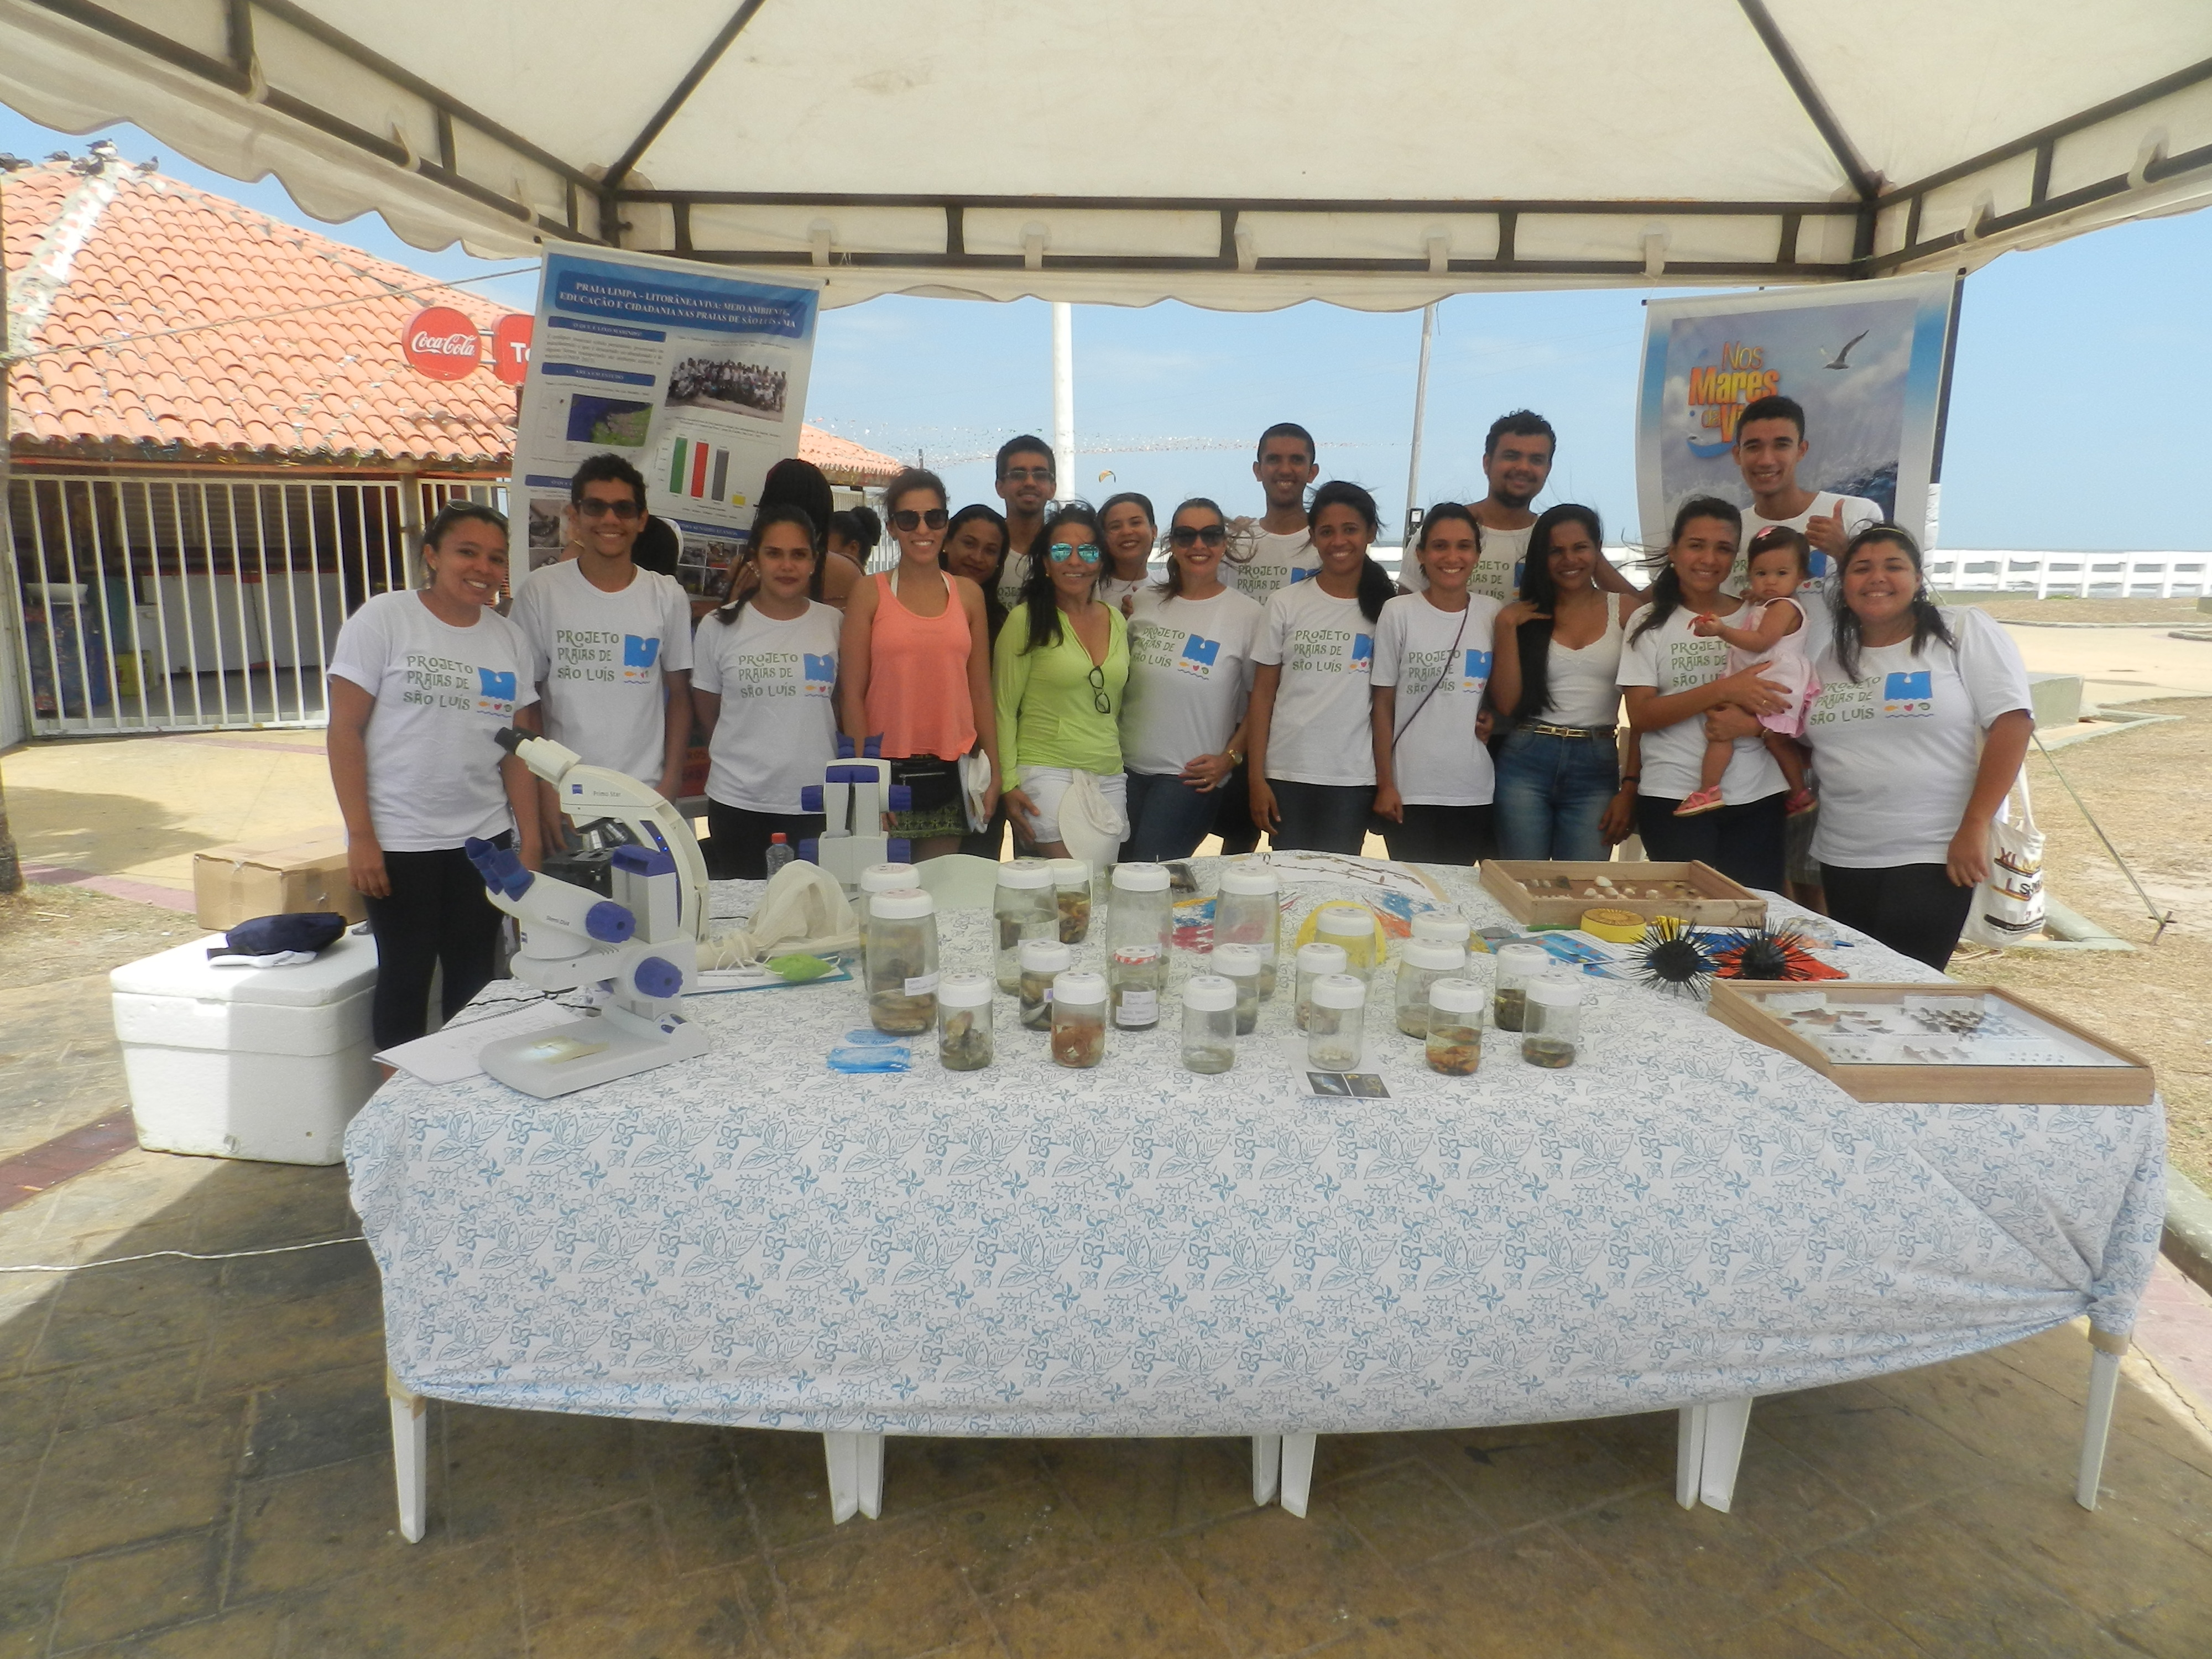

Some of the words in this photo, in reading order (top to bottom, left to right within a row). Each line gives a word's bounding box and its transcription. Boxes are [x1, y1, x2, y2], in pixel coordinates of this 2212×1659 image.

[576, 281, 605, 295] PRAIA
[608, 287, 637, 299] LIMPA
[645, 292, 697, 307] LITORÂNEA
[699, 300, 721, 309] VIVA:
[723, 302, 745, 312] MEIO
[559, 291, 614, 307] EDUCAÇÃO
[617, 301, 623, 309] E
[625, 301, 676, 316] CIDADANIA
[678, 309, 695, 318] NAS
[696, 311, 727, 322] PRAIAS
[728, 315, 740, 324] DE
[742, 315, 759, 325] SÃO
[783, 319, 795, 328] MA
[411, 331, 477, 357] Coca-Cola
[1721, 341, 1764, 371] Nos
[1688, 367, 1780, 406] Mares
[1238, 565, 1287, 580] PROJETO
[1491, 575, 1503, 585] DE
[1237, 578, 1267, 593] PRAIAS
[1270, 580, 1281, 590] DE
[556, 629, 620, 648] PROJETO
[1142, 627, 1186, 640] PROJETO
[1295, 630, 1351, 644] PROJETO
[1162, 642, 1175, 652] DE
[1294, 644, 1327, 659] PRAIAS
[1329, 645, 1342, 656] DE
[406, 655, 473, 674] PROJETO
[557, 648, 596, 665] PRAIAS
[598, 649, 612, 662] DE
[739, 652, 799, 667] PROJETO
[1148, 655, 1172, 667] LUÍS
[1408, 649, 1461, 667] PROJETO
[1671, 655, 1710, 671] PRAIAS
[1714, 655, 1728, 666] DE
[557, 665, 582, 680] SÃO
[586, 666, 615, 682] LUÍS
[1292, 659, 1312, 671] SÃO
[1317, 659, 1342, 672] LUÍS
[1408, 666, 1442, 682] PRAIAS
[407, 670, 452, 690] PRAIAS
[455, 676, 469, 690] DE
[739, 667, 776, 684] PRAIAS
[779, 667, 794, 679] DE
[1672, 672, 1697, 687] SÃO
[740, 685, 764, 698] SÃO
[768, 682, 796, 697] LUÍS
[1406, 683, 1428, 695] SÃO
[1823, 676, 1881, 693] PROJETO
[403, 690, 434, 705] SÃO
[439, 693, 470, 711] LUÍS
[1815, 691, 1853, 709] PRAIAS
[1858, 691, 1873, 702] DE
[1809, 710, 1836, 726] SÃO
[1841, 705, 1875, 722] LUÍS
